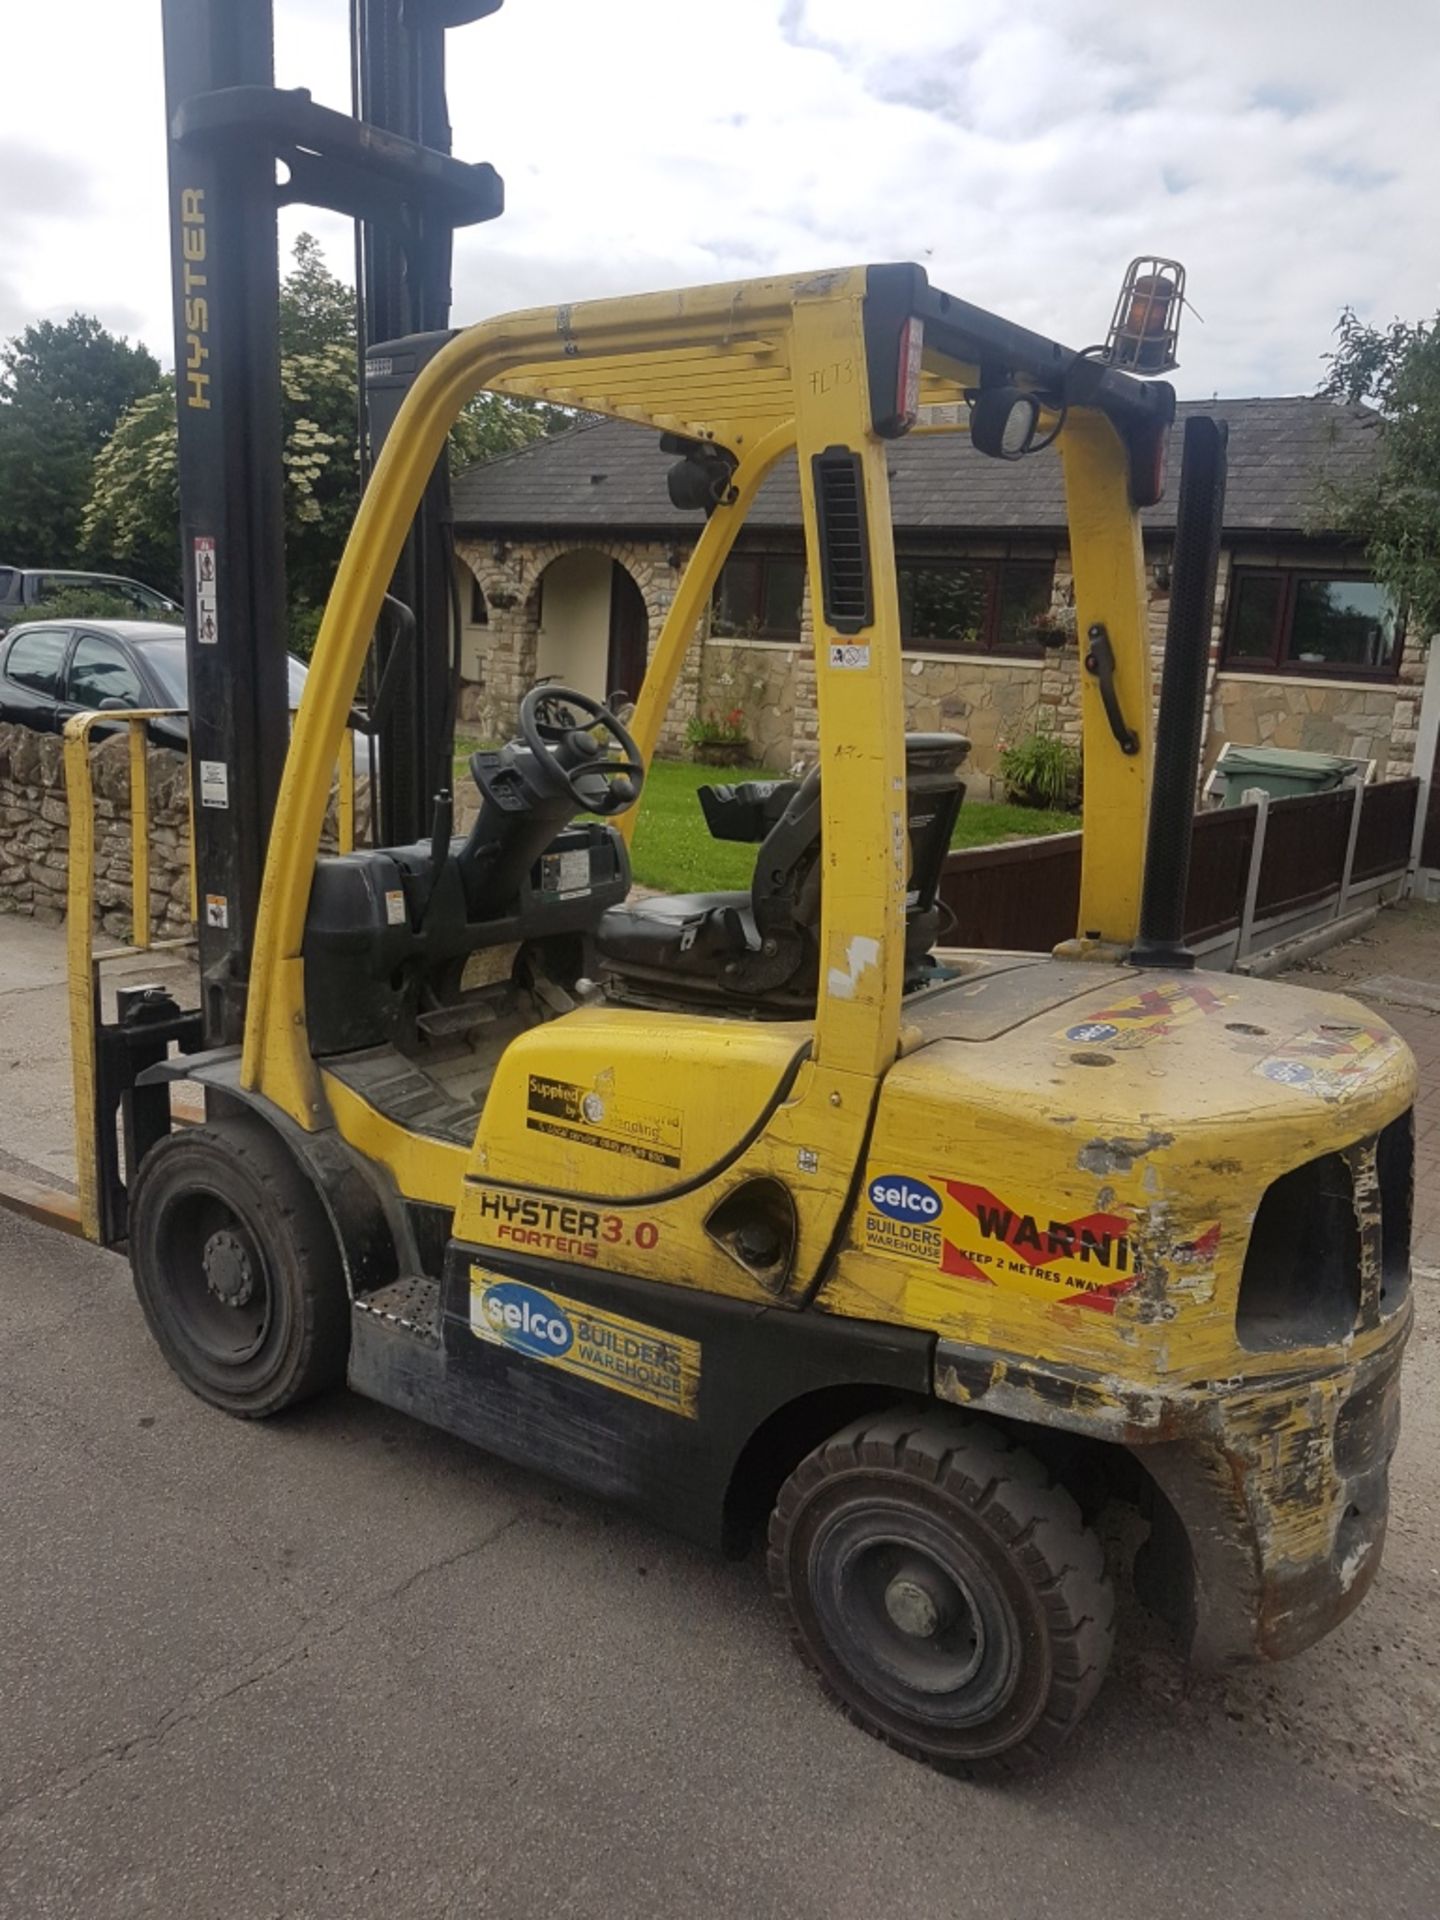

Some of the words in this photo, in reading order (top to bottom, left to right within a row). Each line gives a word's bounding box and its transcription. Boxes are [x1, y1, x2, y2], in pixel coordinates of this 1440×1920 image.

[182, 188, 210, 408] HYSTER
[530, 1078, 579, 1102] Supplied
[566, 1103, 576, 1118] by
[480, 1191, 600, 1239] HYSTER
[601, 1213, 659, 1250] 3.0
[872, 1184, 940, 1215] selco
[498, 1223, 600, 1259] FORTENS
[866, 1217, 941, 1245] BUILDERS
[867, 1231, 941, 1259] WAREHOUSE
[959, 1248, 993, 1265] KEEP
[996, 1258, 1004, 1269] 2
[1008, 1262, 1061, 1283] METRES
[1065, 1276, 1104, 1296] AWAY
[486, 1294, 569, 1346] selco
[577, 1321, 682, 1375] BUILDERS
[578, 1345, 682, 1394] WAREHOUSE
